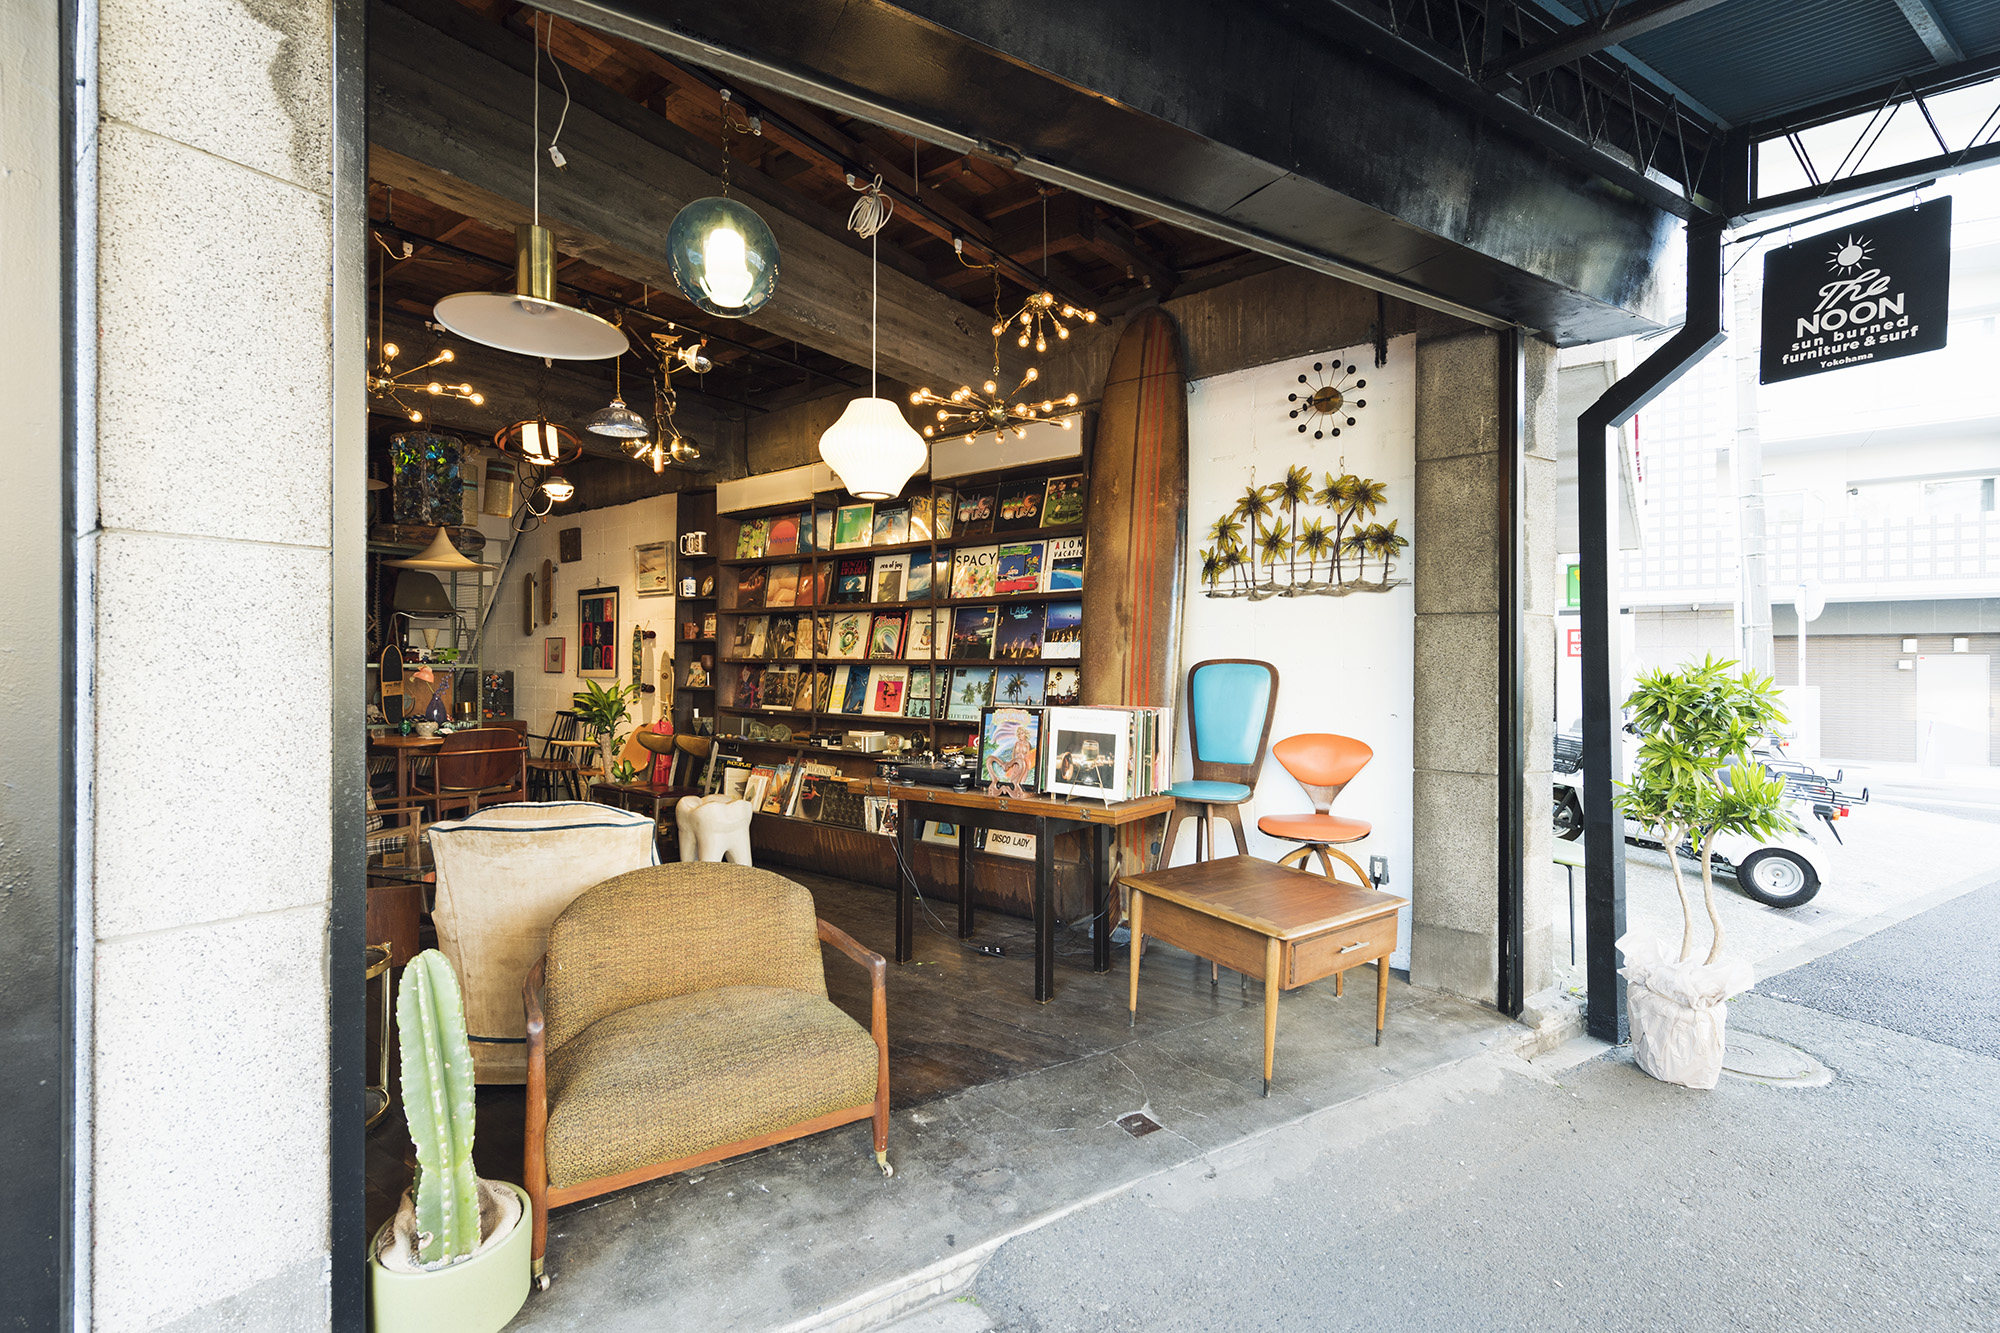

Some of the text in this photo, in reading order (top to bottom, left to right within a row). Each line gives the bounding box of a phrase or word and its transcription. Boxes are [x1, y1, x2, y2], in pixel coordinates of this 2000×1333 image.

[1813, 268, 1891, 313] The
[1796, 293, 1905, 338] NOON
[1781, 325, 1919, 365] furniture & surf
[1791, 315, 1909, 352] sun burned
[1820, 352, 1874, 368] Yokohama
[1055, 542, 1060, 550] A
[955, 552, 997, 568] SPACY
[991, 833, 1031, 848] DISCO LADY
